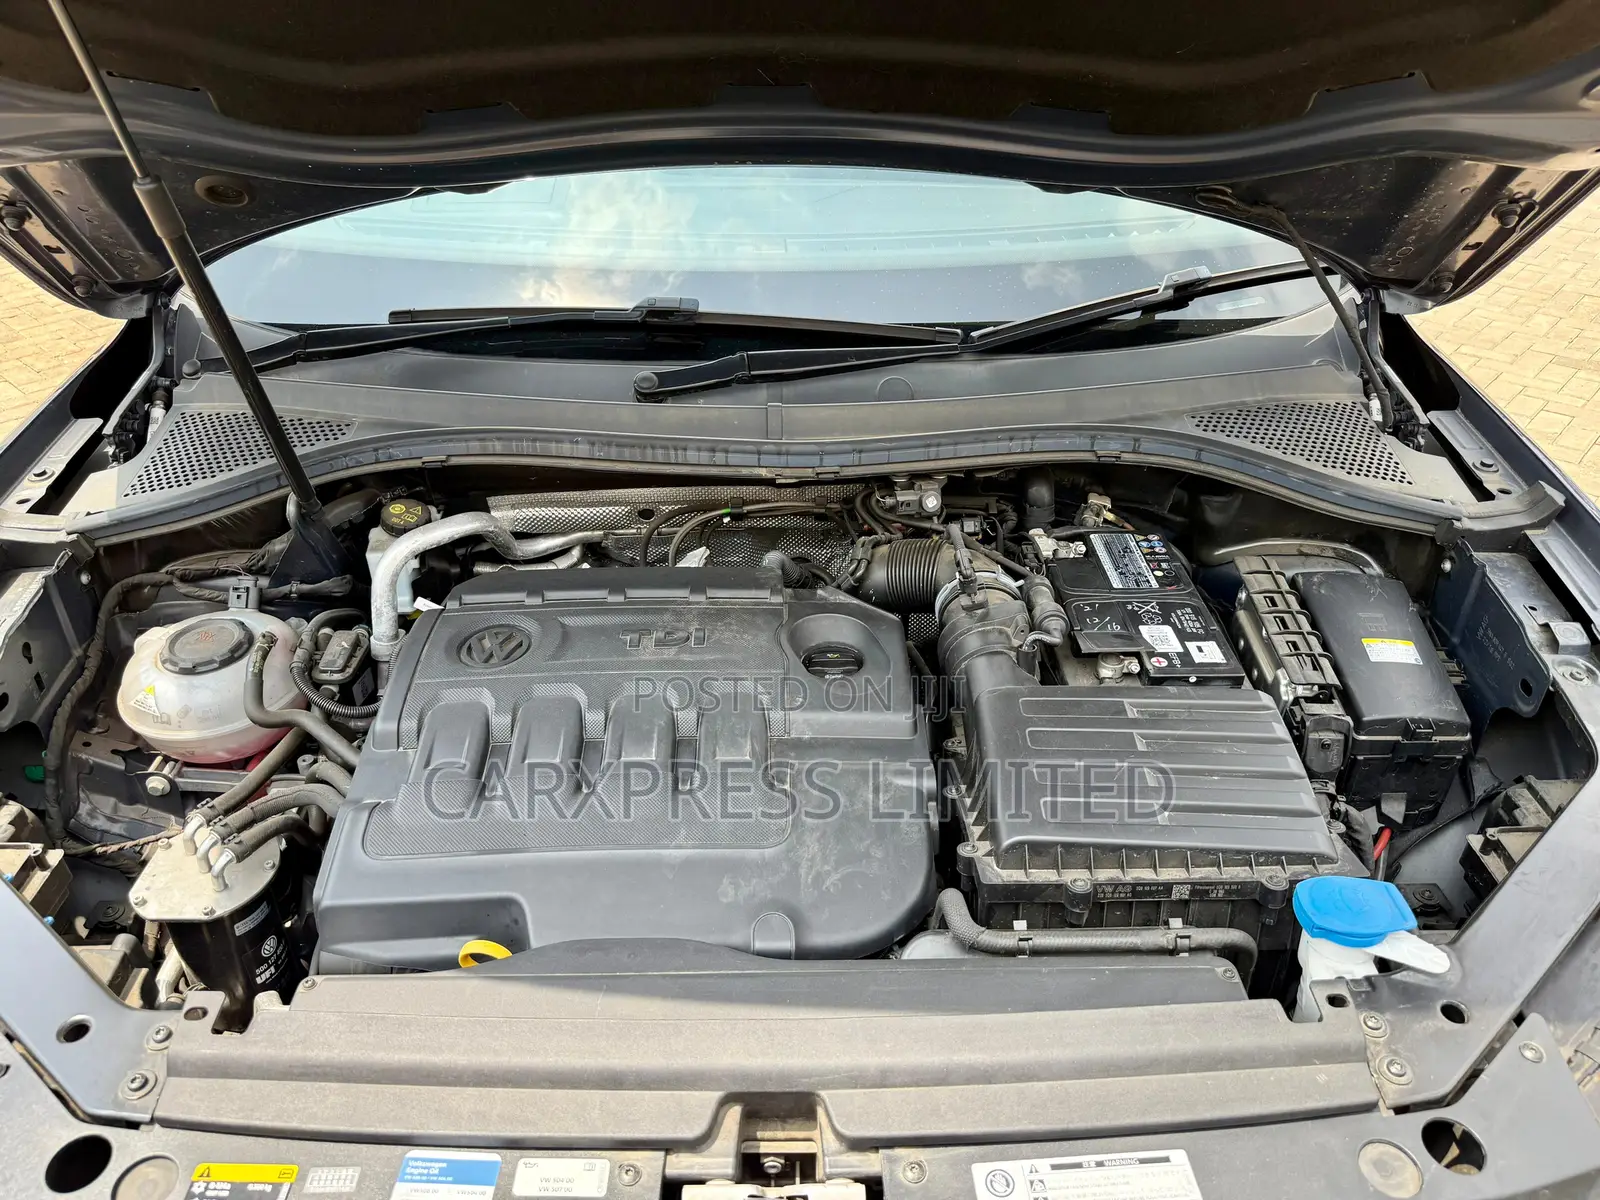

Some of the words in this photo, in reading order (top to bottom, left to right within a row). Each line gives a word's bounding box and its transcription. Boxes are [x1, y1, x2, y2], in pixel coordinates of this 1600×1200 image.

[619, 627, 707, 650] TDI
[1096, 885, 1115, 893] VW
[1115, 885, 1133, 893] AG
[255, 965, 276, 985] UFI
[408, 1160, 448, 1168] Volkswagen
[1103, 1157, 1140, 1167] WARNING
